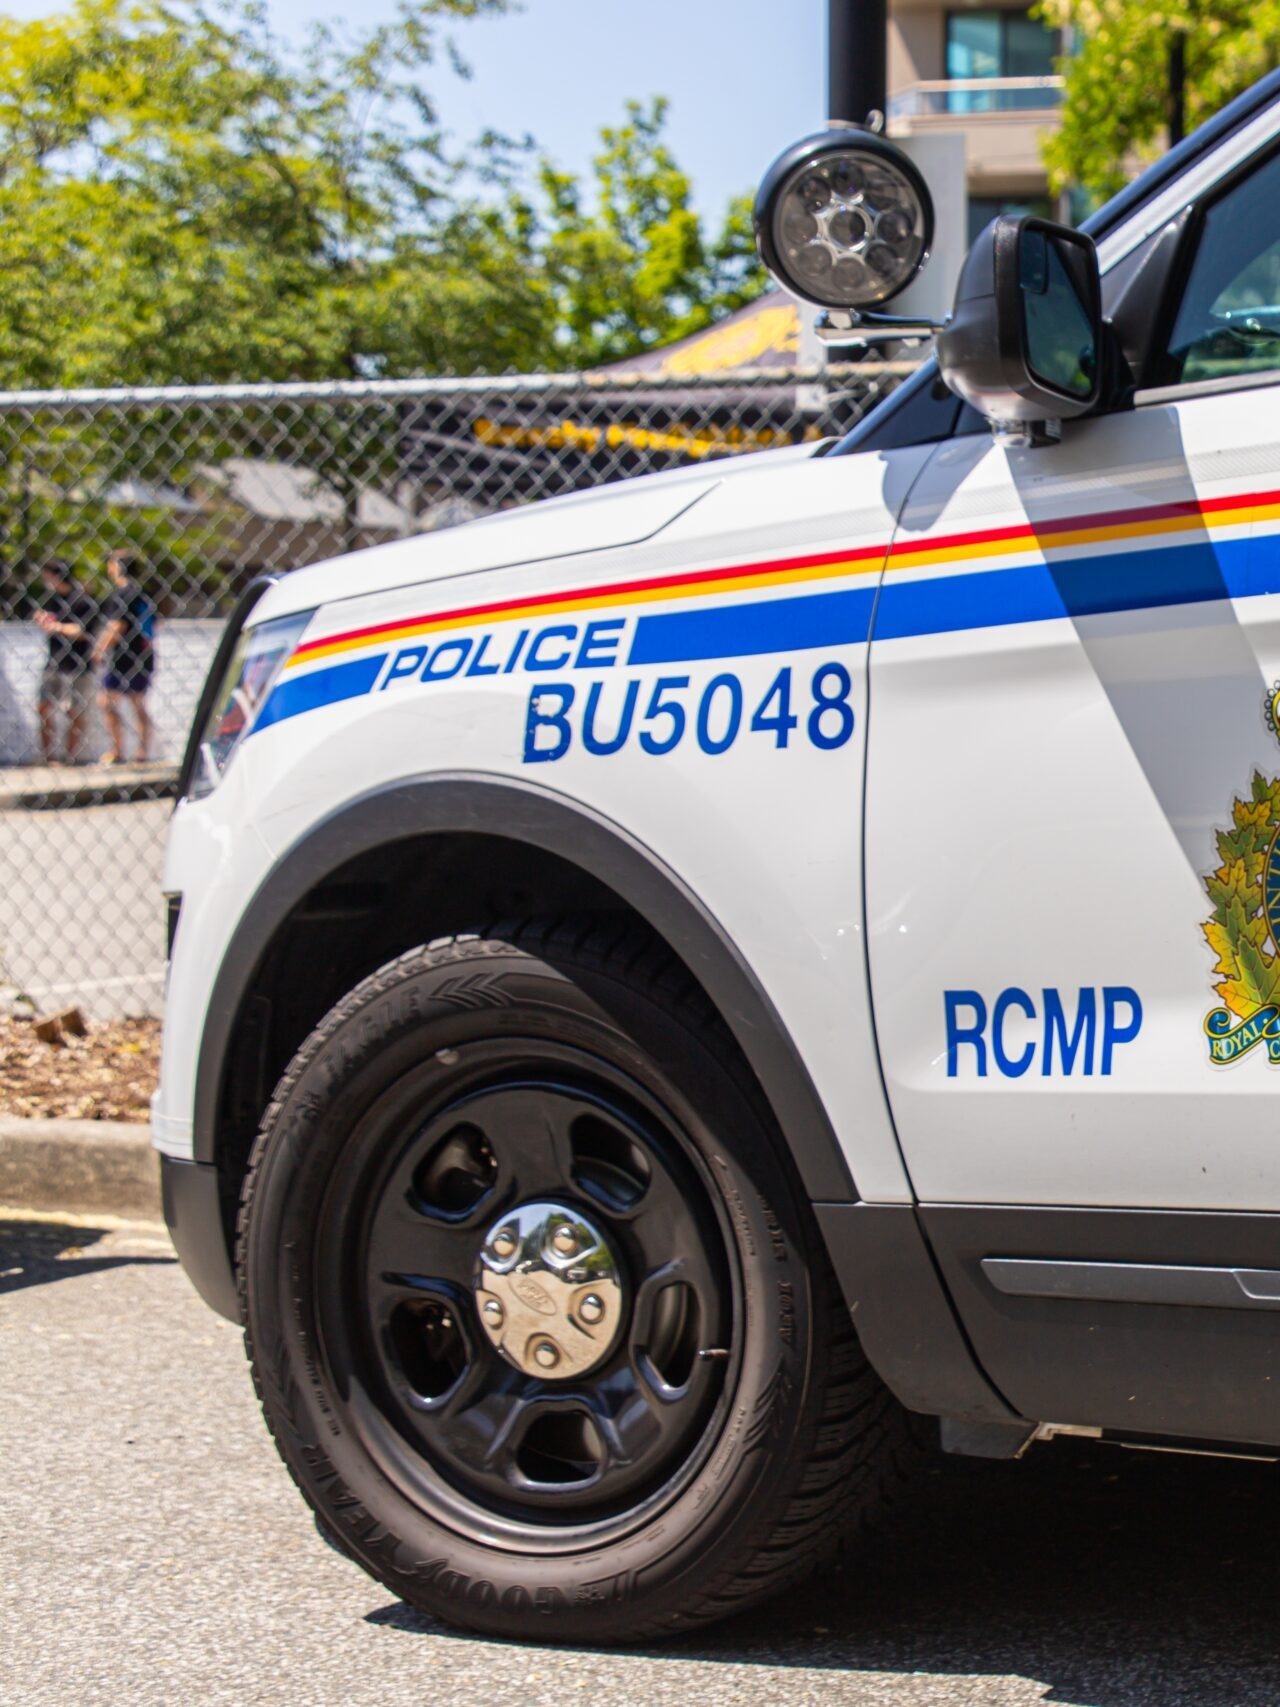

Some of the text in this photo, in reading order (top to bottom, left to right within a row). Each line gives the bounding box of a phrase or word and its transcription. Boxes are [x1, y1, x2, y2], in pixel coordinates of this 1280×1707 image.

[380, 618, 627, 691] POLICE
[522, 661, 855, 764] BU5048
[944, 986, 1143, 1078] RCMP
[1211, 1020, 1263, 1057] ROYAL
